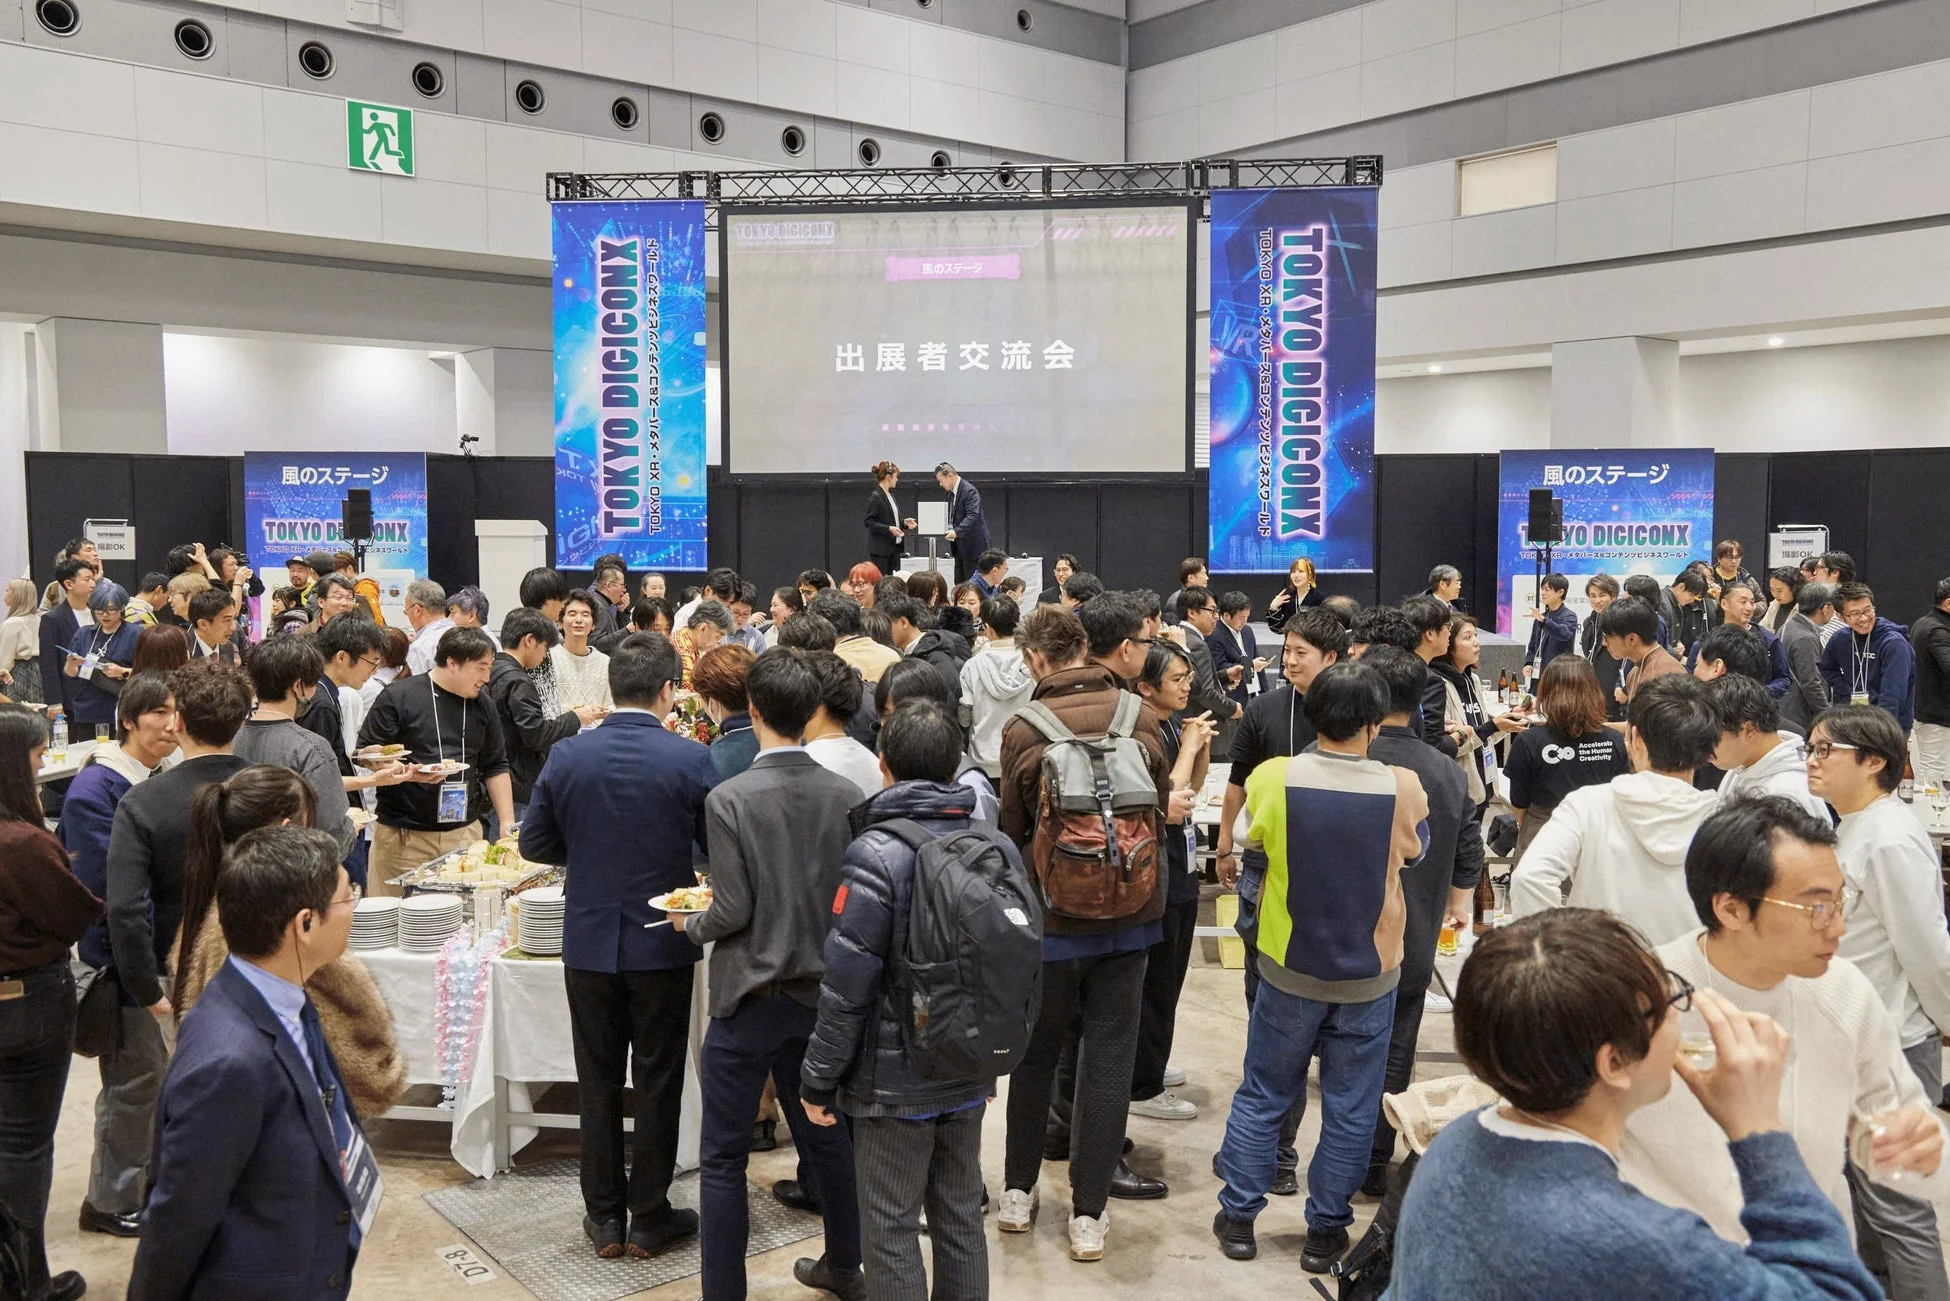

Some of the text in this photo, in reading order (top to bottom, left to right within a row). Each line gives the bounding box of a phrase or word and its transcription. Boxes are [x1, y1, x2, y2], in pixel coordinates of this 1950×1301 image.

[736, 224, 776, 238] TOKYO
[1260, 229, 1272, 279] TOKYO
[922, 263, 983, 274] 風のステージ
[835, 339, 1075, 372] 出展者交流会
[600, 240, 640, 533] TOKYO DIGICONX
[1281, 228, 1323, 535] TOKYO DIGICONX
[282, 466, 389, 485] 風のステージ
[1543, 464, 1670, 486] 風のステージ
[650, 486, 660, 533] TOKYO
[265, 521, 322, 541] TOKYO
[1593, 524, 1689, 546] DIGICONX
[1579, 754, 1612, 762] Creativity
